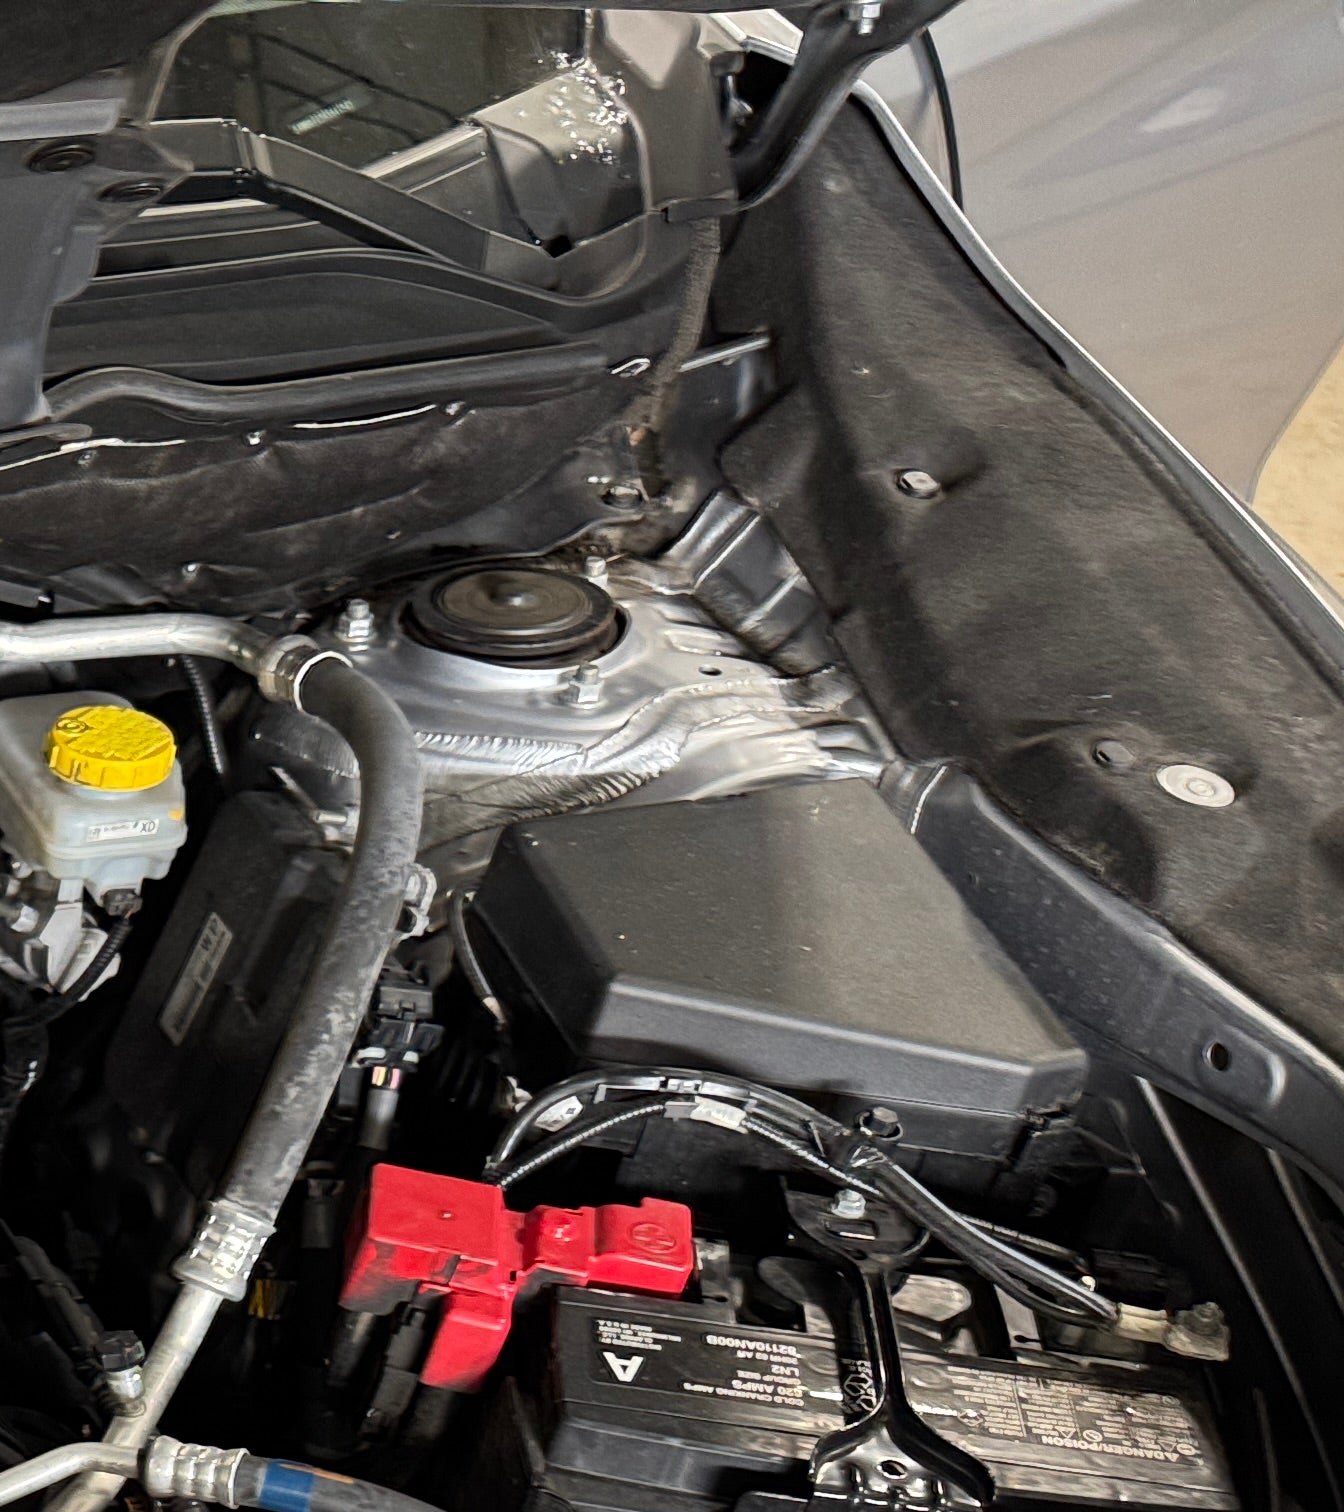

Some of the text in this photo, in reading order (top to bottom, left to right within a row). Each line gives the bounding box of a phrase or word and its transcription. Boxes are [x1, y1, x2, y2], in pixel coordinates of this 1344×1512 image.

[602, 1351, 644, 1382] A
[770, 1364, 800, 1377] LN2
[731, 1379, 774, 1394] AMPS
[773, 1395, 804, 1407] COLD
[1041, 1435, 1166, 1460] DANGER/POISON
